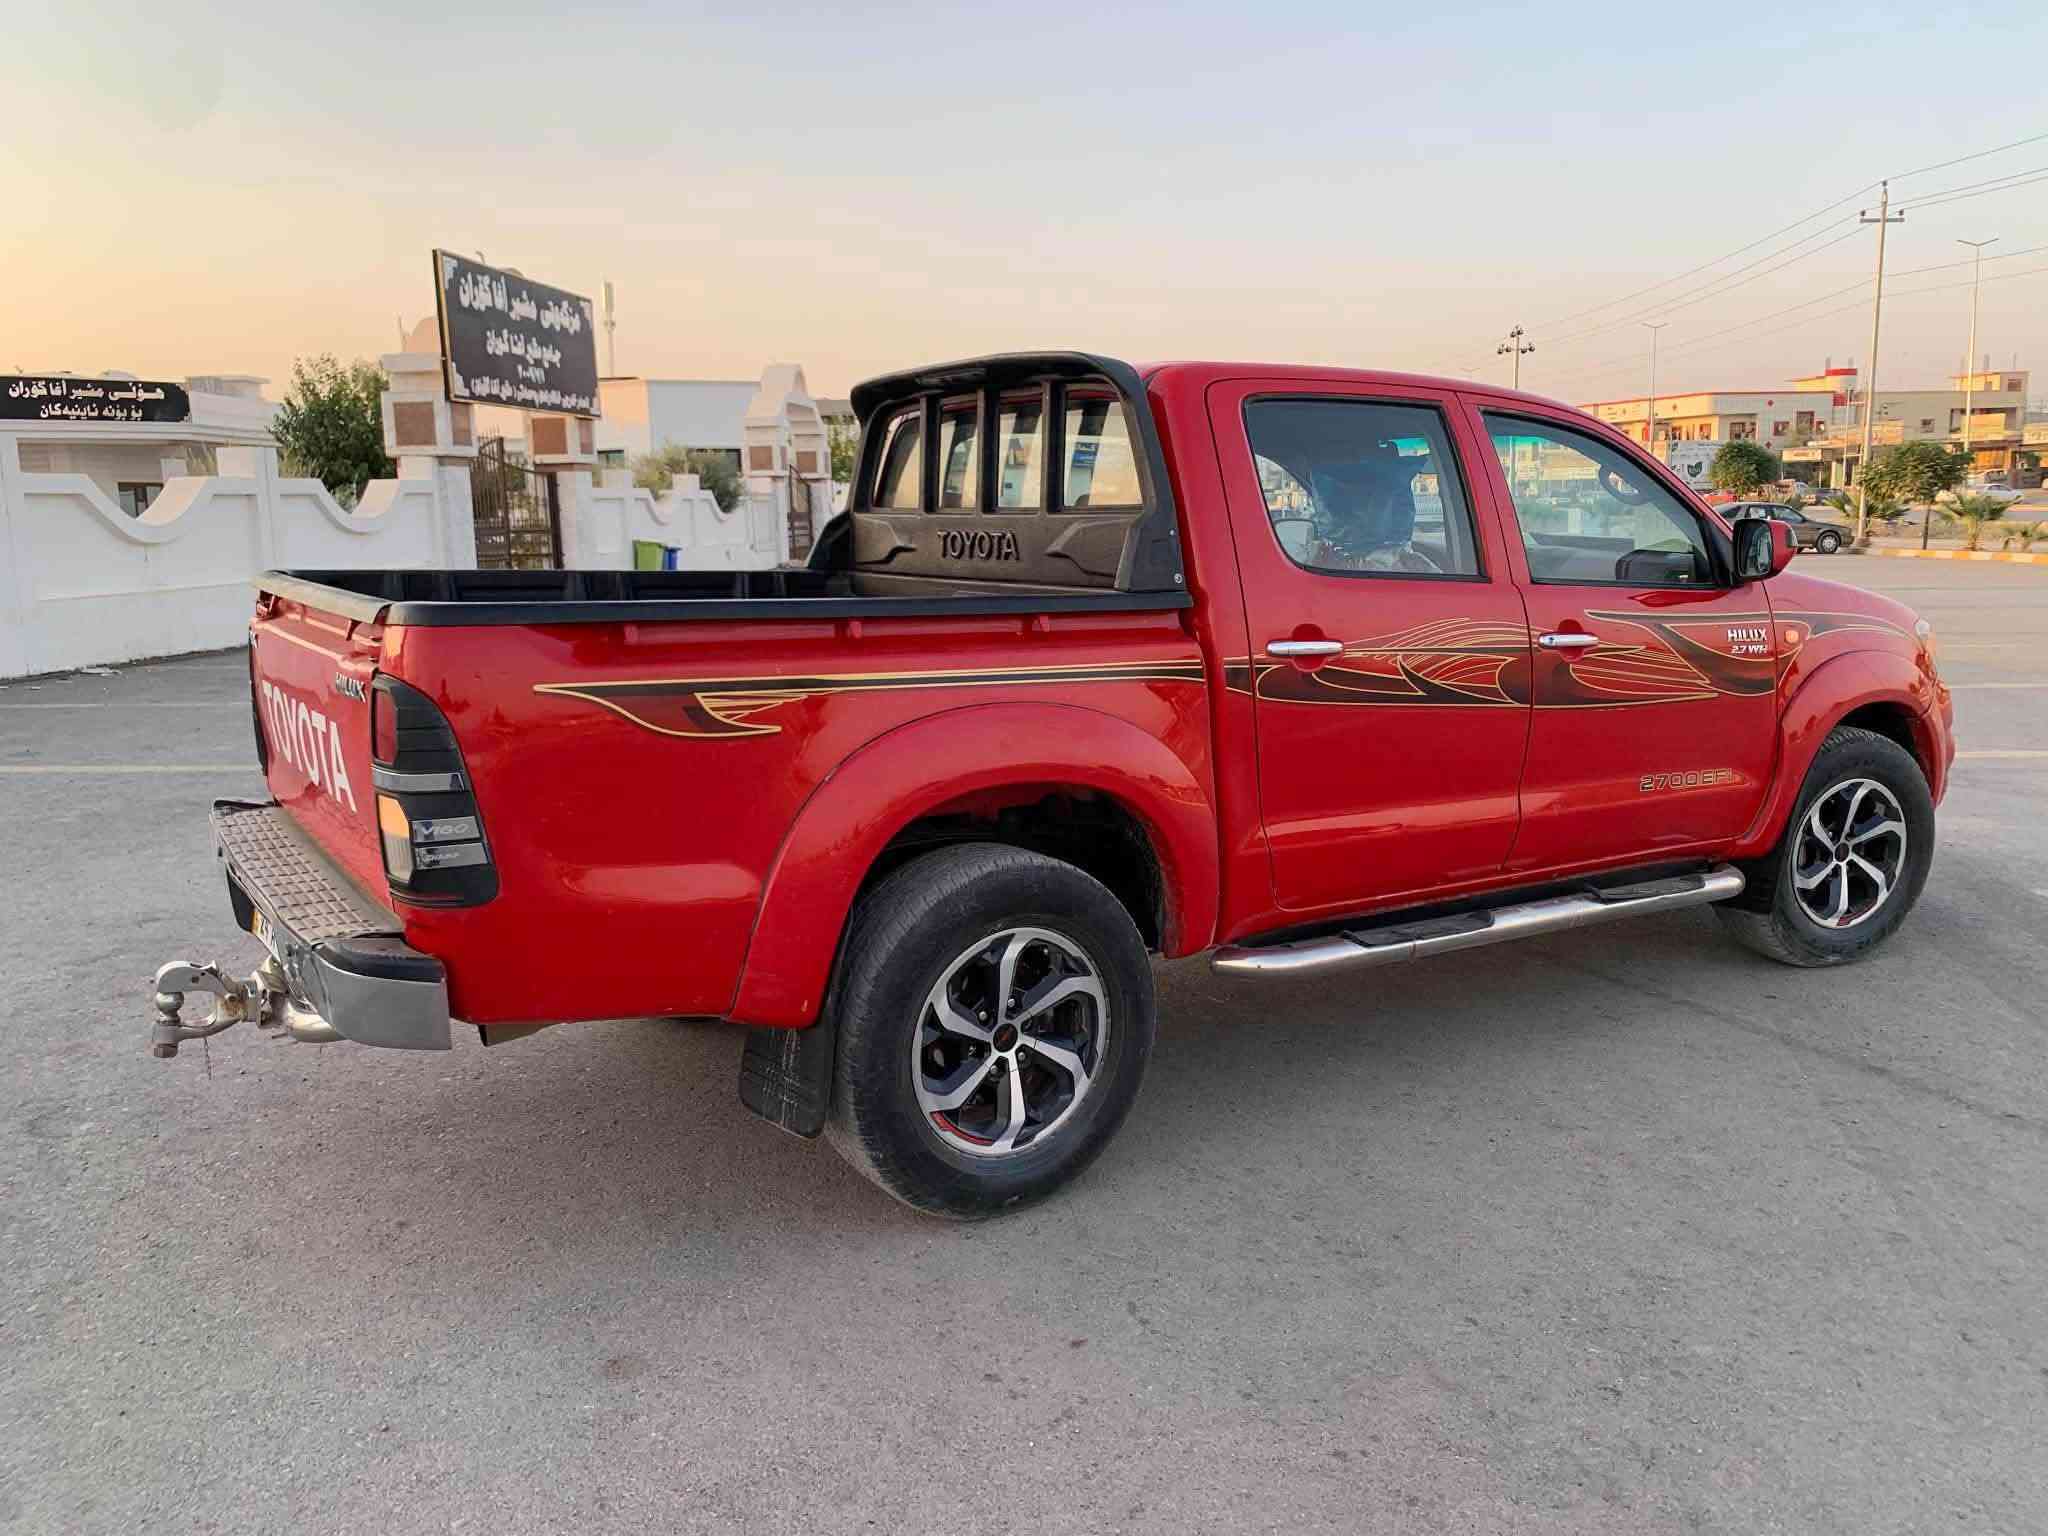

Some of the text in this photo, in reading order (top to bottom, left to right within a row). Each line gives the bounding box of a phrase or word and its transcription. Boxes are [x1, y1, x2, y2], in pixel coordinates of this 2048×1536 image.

[936, 530, 1020, 561] TOYOTA
[1727, 628, 1767, 642] HILUX
[262, 679, 357, 813] TOYOTA
[420, 822, 470, 836] VIGO
